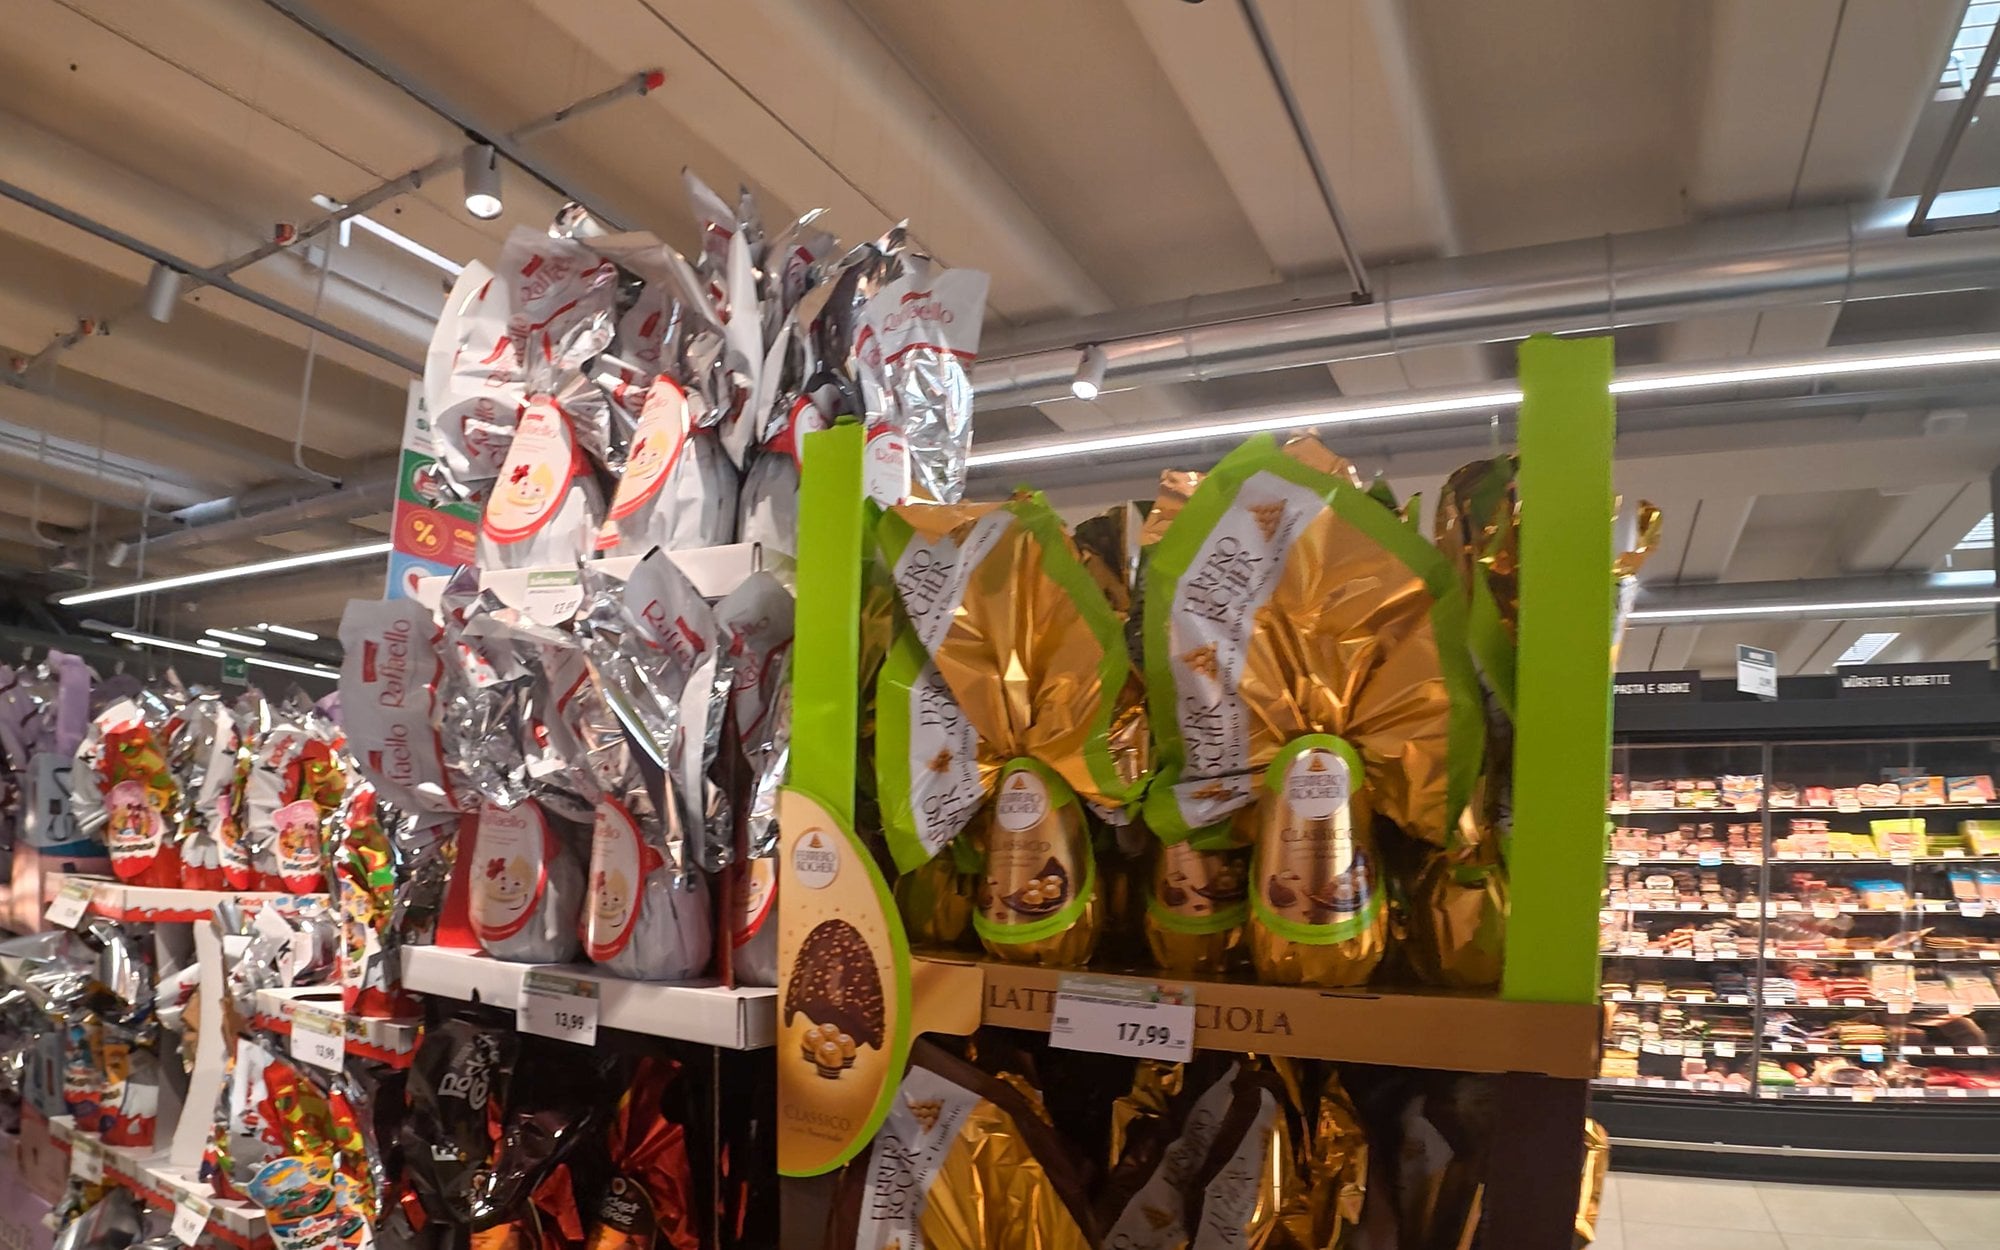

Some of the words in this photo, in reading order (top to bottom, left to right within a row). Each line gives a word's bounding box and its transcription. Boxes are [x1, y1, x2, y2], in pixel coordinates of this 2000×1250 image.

[379, 619, 411, 708] Raffaello
[1612, 684, 1646, 695] PASTA
[1646, 683, 1656, 694] E
[1657, 682, 1691, 693] SUGHI
[1841, 674, 1890, 688] WÜRSTEL
[1892, 675, 1901, 686] E
[1902, 674, 1951, 686] CUBETTI
[384, 723, 413, 787] faello
[554, 1011, 585, 1031] 13,99
[1116, 1022, 1171, 1047] 17,99
[783, 1104, 850, 1131] CLASSICO
